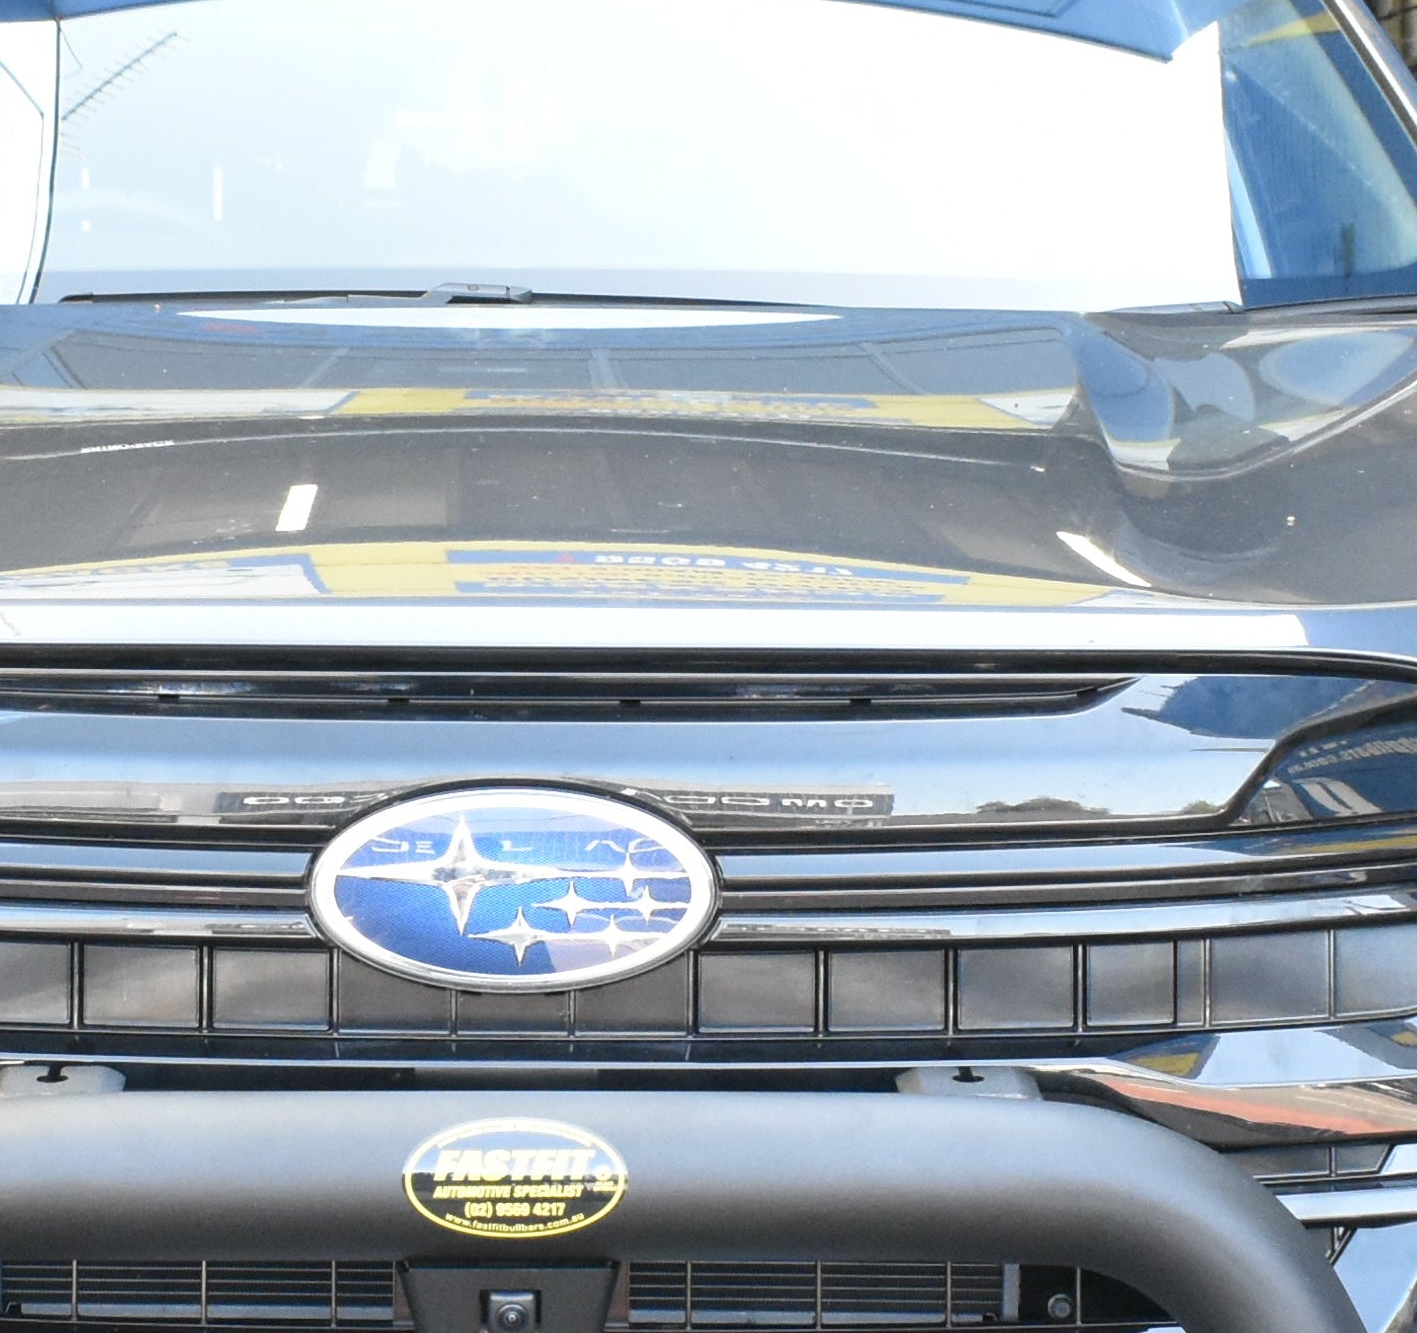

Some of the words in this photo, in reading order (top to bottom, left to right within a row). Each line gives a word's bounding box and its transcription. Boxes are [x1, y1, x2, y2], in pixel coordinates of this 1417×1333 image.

[434, 1149, 596, 1181] FASTFIT
[433, 1185, 511, 1198] AUTOMOTIVE
[513, 1185, 584, 1198] SPECIALIST
[463, 1202, 493, 1218] (02)
[533, 1202, 566, 1216] 4217
[445, 1212, 585, 1233] www.fastfitbullbars.com.au
